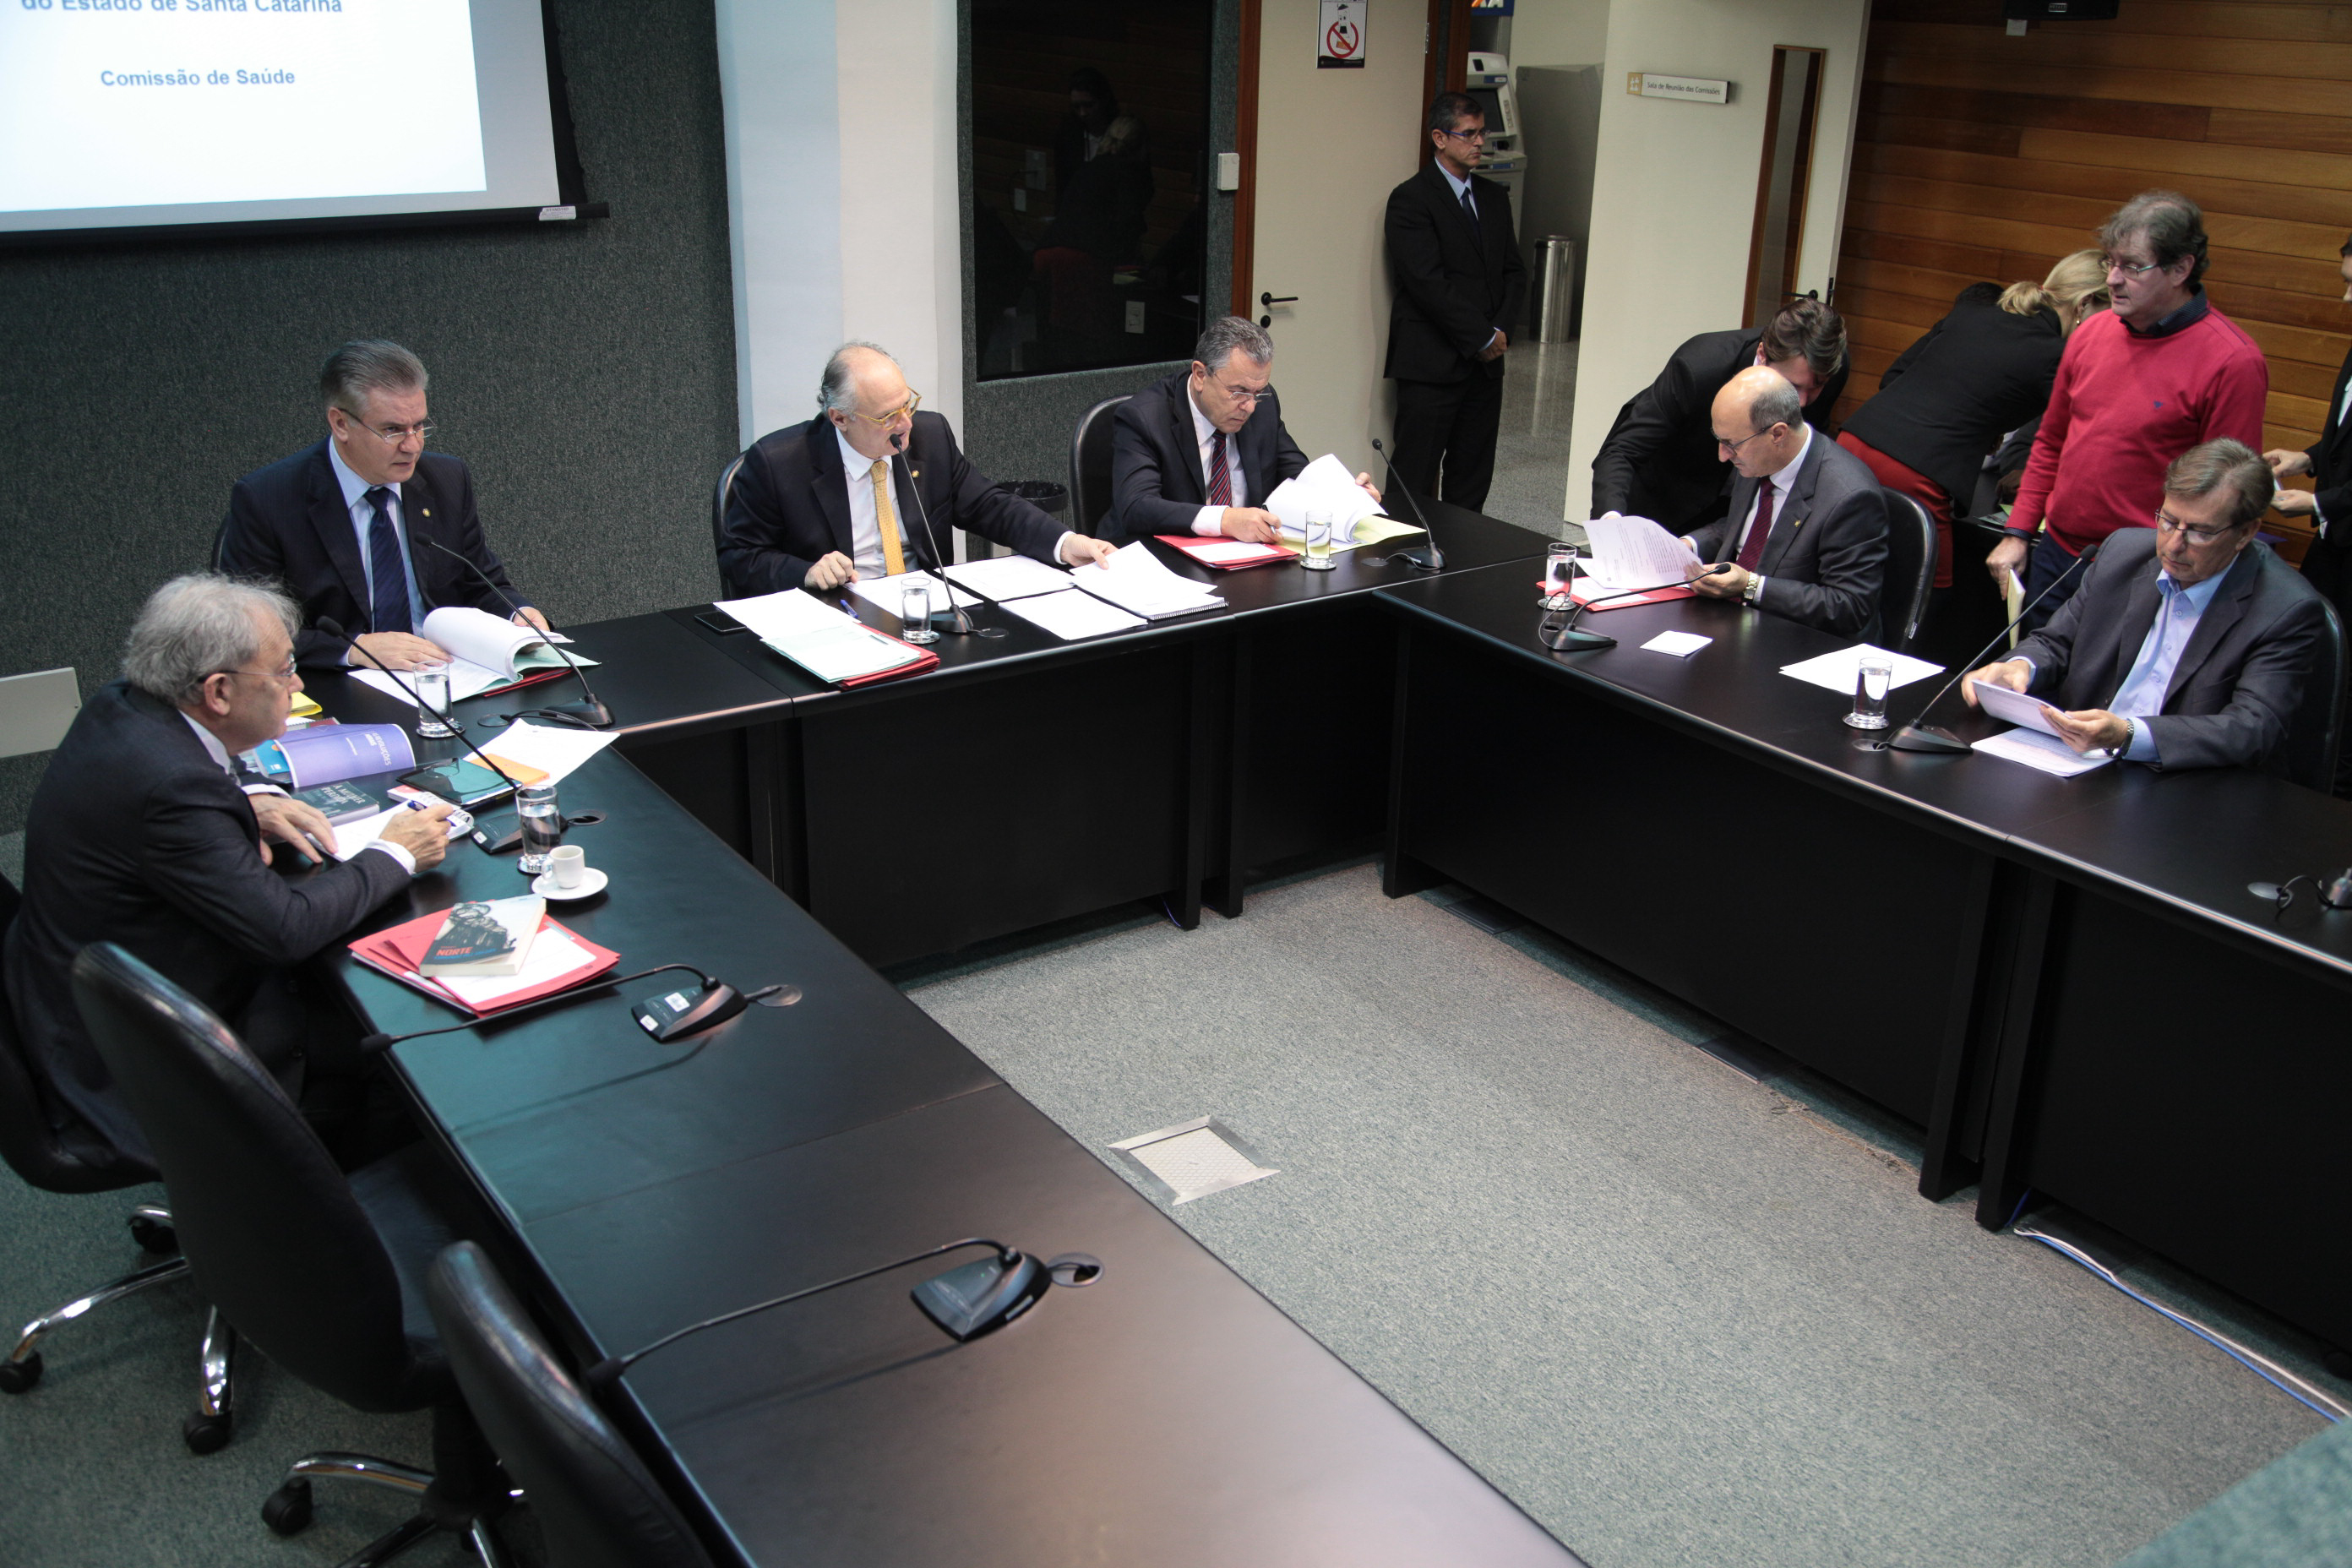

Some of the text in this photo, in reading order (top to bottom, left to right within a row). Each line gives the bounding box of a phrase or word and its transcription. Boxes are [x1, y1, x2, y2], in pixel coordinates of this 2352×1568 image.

[21, 0, 343, 13] do Estado de Santa Catarina
[101, 68, 296, 86] Comissão de Saúde
[1666, 83, 1685, 91] Reunião
[1695, 86, 1720, 95] Comissões
[437, 947, 473, 956] NORTE
